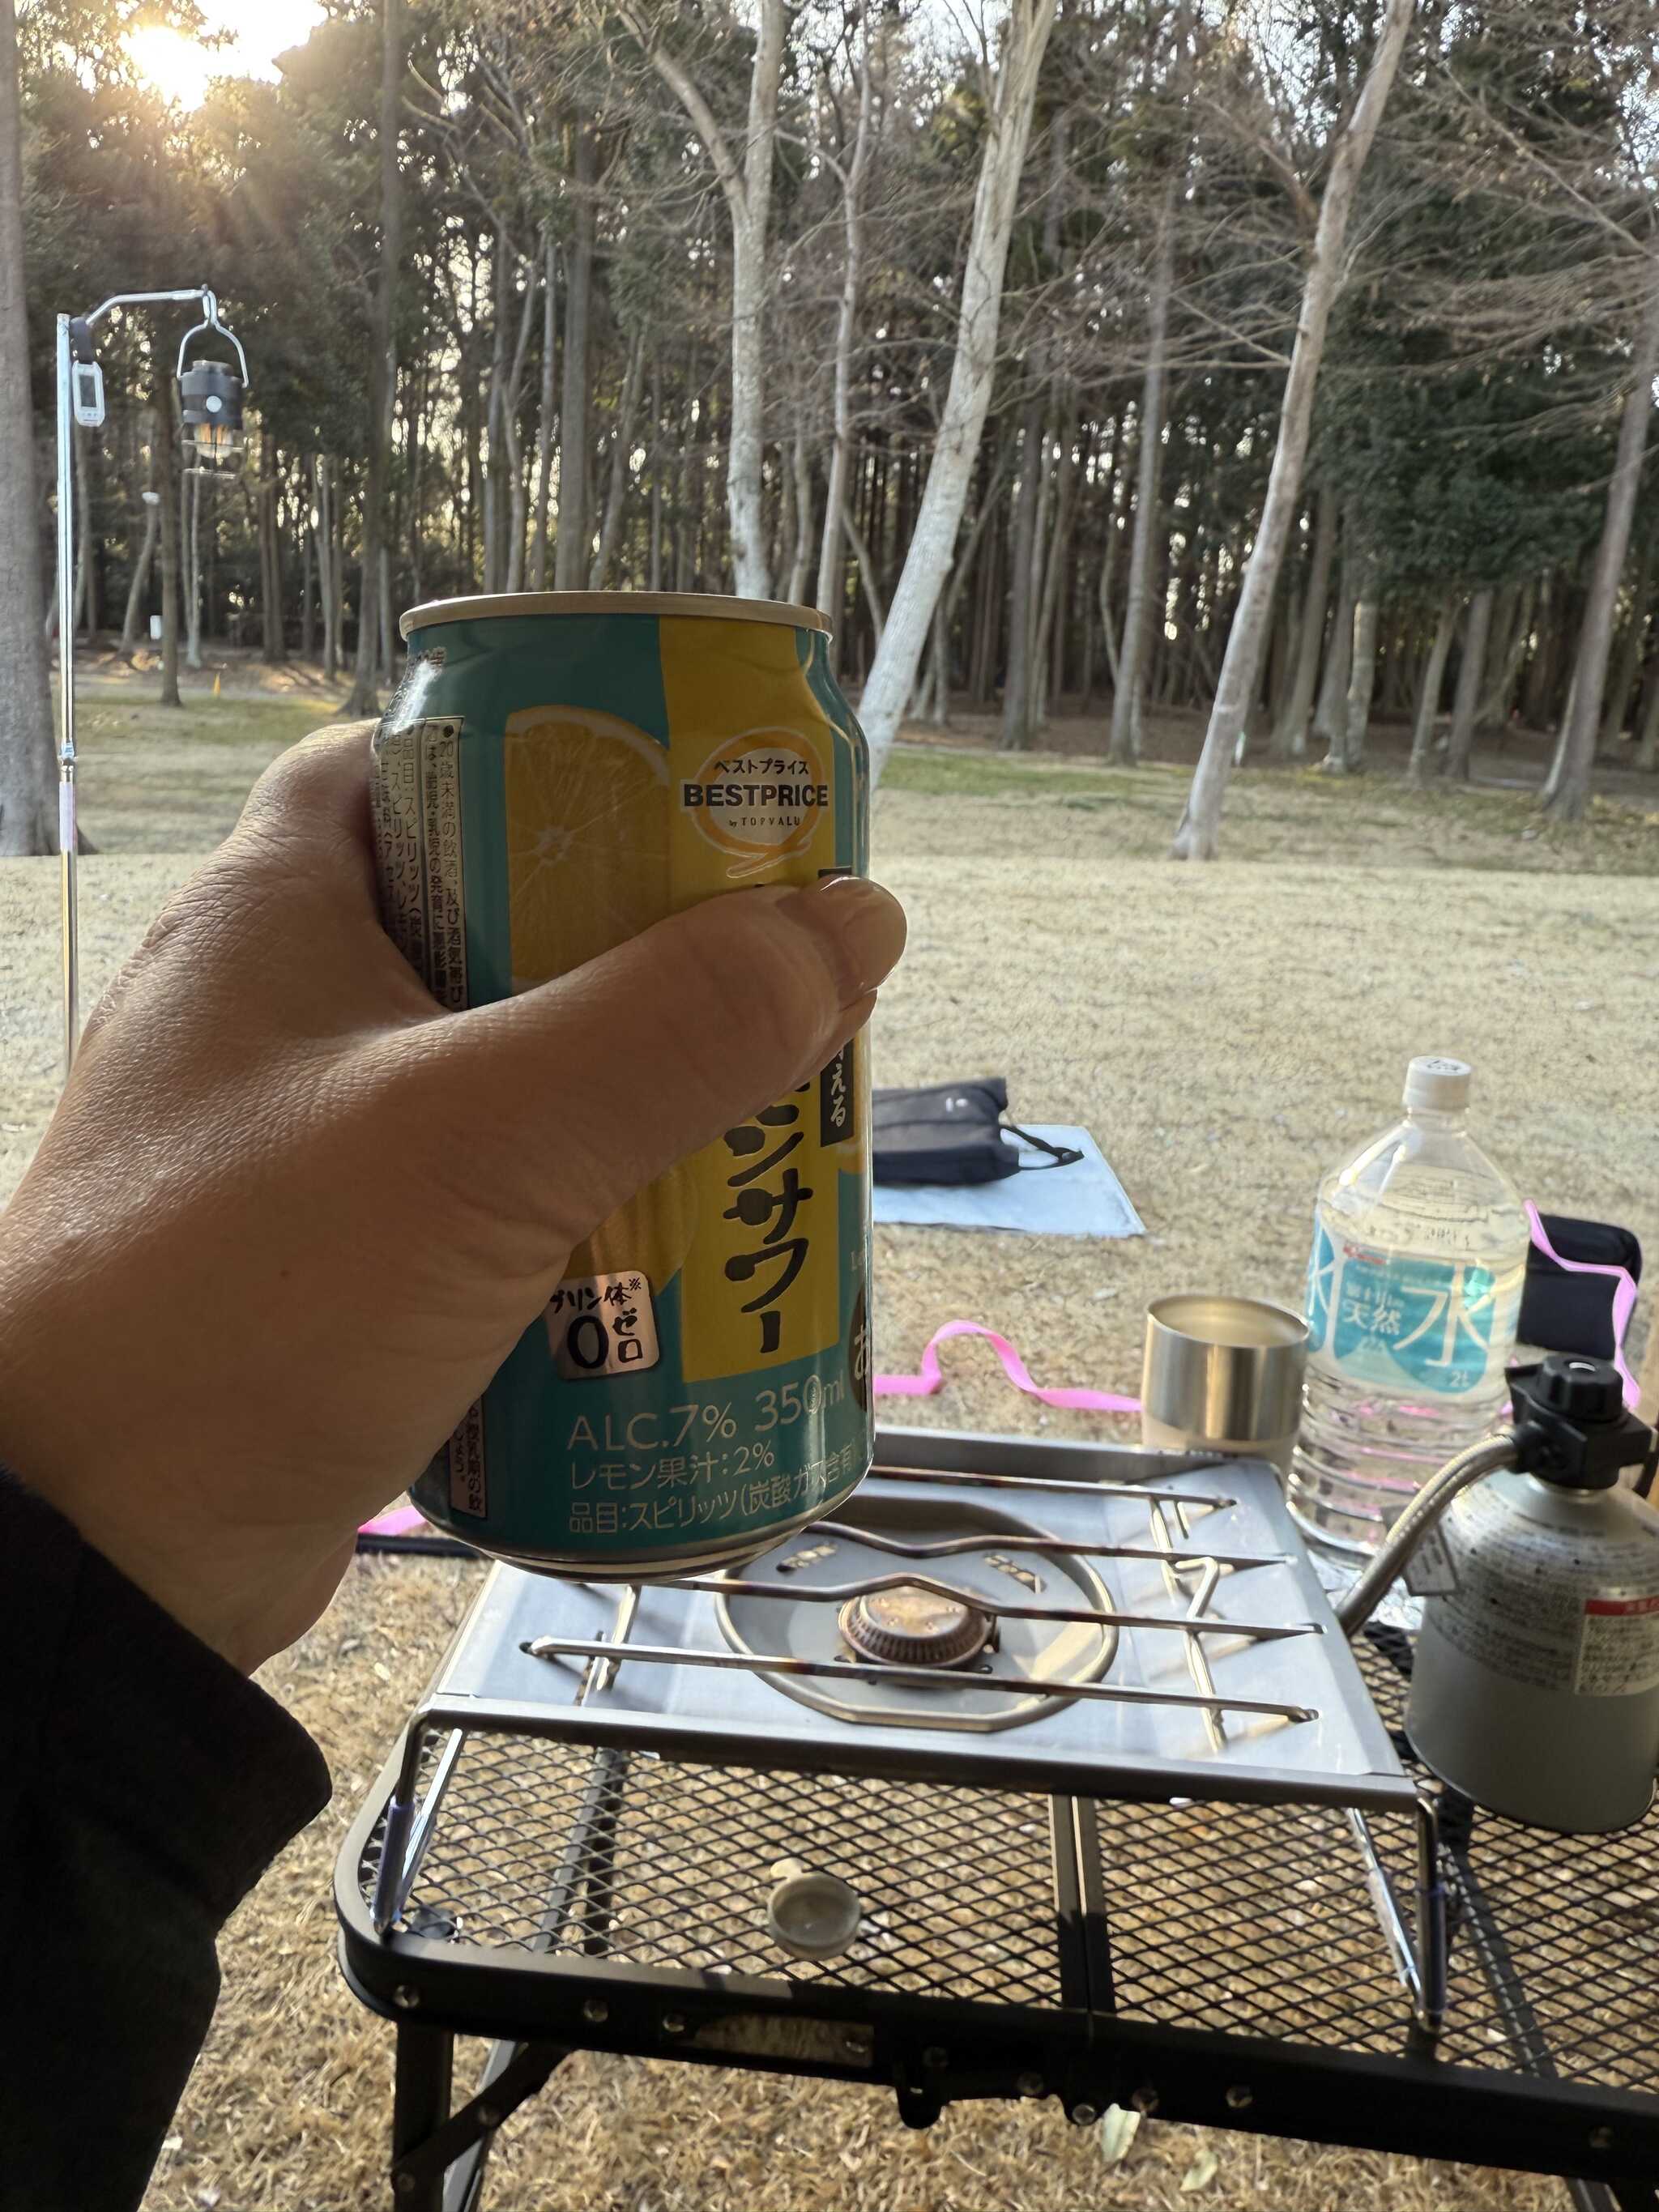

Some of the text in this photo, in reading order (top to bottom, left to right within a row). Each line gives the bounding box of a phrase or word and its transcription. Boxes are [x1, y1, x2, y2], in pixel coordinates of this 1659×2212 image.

[714, 758, 810, 775] ベストプライス
[684, 783, 829, 807] BESTPRICE
[741, 816, 801, 827] TOPVALU
[723, 1082, 814, 1354] ンサワー
[612, 1306, 643, 1364] ゼロ
[568, 1370, 846, 1451] ALC.7% 350ml
